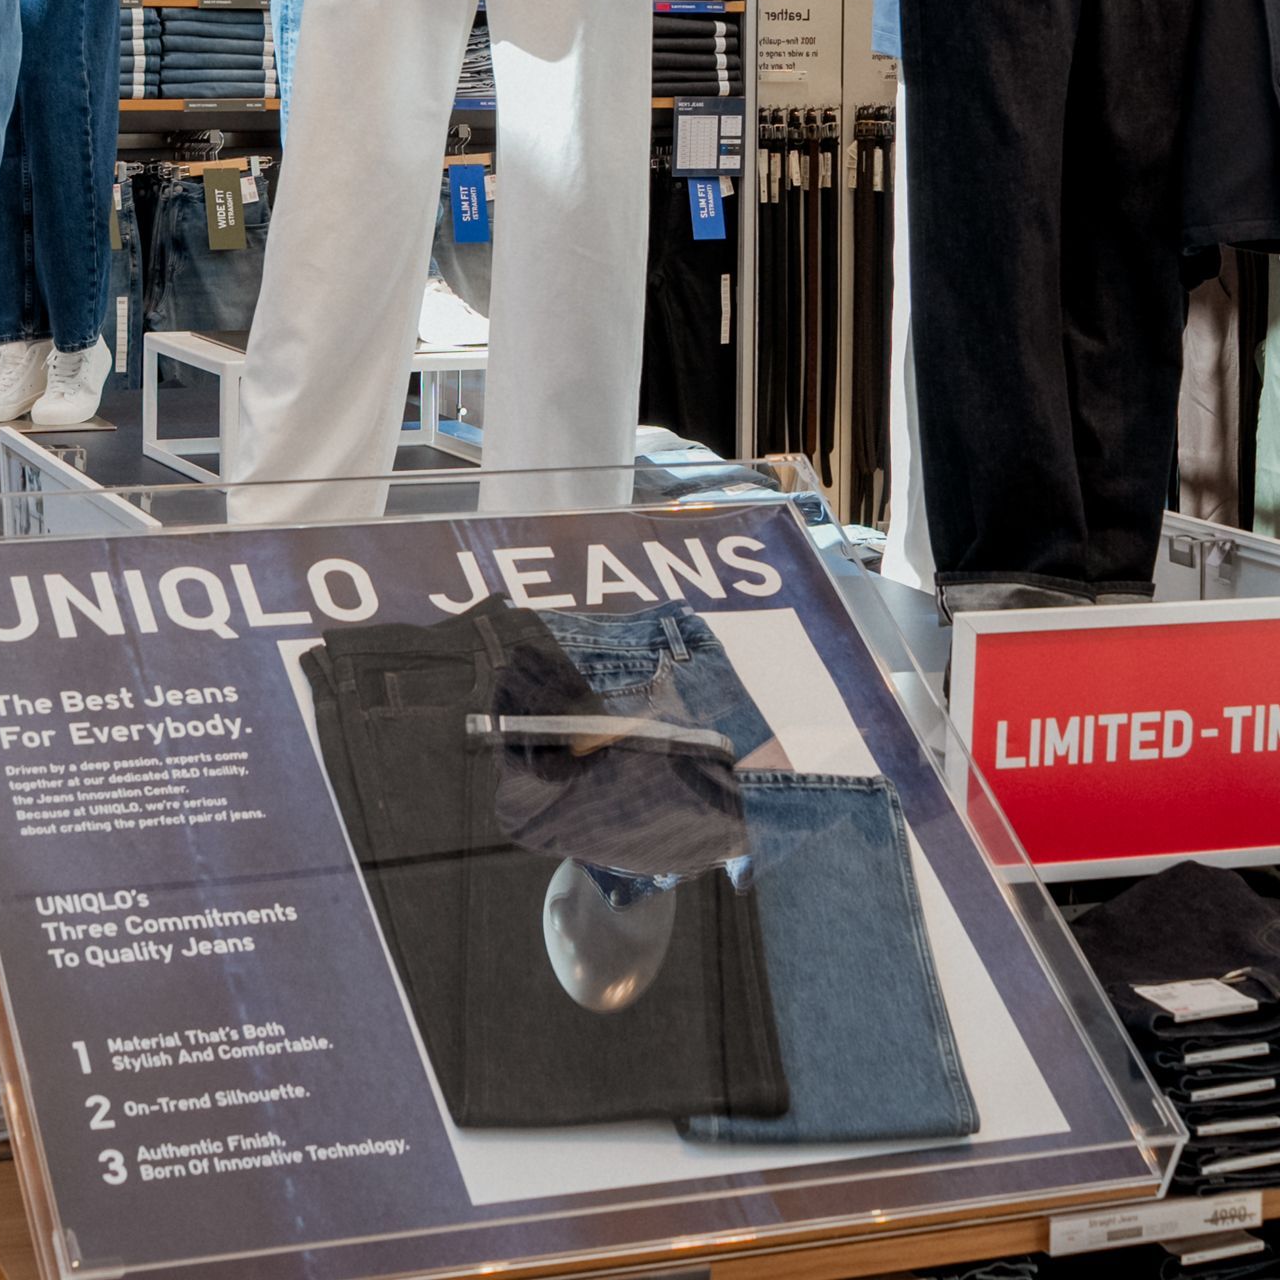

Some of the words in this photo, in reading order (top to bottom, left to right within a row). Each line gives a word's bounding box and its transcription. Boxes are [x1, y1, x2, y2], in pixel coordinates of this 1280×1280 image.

[215, 188, 225, 203] FIT
[460, 186, 469, 199] FIT
[697, 184, 705, 197] FIT
[217, 204, 228, 230] WIDE
[461, 201, 471, 222] SLIM
[699, 201, 708, 218] SLIM
[427, 535, 783, 615] JEANS
[60, 687, 135, 714] Best
[144, 684, 239, 709] Jeans
[68, 713, 254, 748] Everybody.
[5, 765, 48, 777] Driven
[80, 759, 111, 773] deep
[113, 756, 163, 771] passion,
[166, 753, 212, 768] experts
[214, 750, 248, 762] come
[8, 778, 64, 792] together
[108, 770, 170, 785] dedicated
[172, 768, 200, 780] R&D
[36, 791, 75, 804] Jeans
[77, 787, 142, 802] Innovation
[144, 783, 190, 796] Center.
[16, 808, 70, 821] Because
[145, 799, 180, 811] we're
[183, 795, 228, 808] serious
[20, 823, 57, 836] about
[60, 819, 112, 834] crafting
[138, 813, 186, 830] perfect
[188, 811, 213, 826] pair
[230, 808, 266, 823] jeans.
[35, 889, 150, 916] UNIQLO's
[41, 920, 118, 942] Three
[125, 902, 298, 935] Commitments
[47, 948, 80, 969] To
[84, 941, 174, 968] Quality
[180, 934, 256, 958] Jeans
[72, 1040, 92, 1075] 1
[106, 1032, 182, 1055] Material
[185, 1026, 240, 1046] That's
[242, 1021, 286, 1040] Both
[111, 1051, 173, 1073] Stylish
[178, 1047, 215, 1065] And
[217, 1035, 334, 1060] Comfortable.
[84, 1094, 117, 1131] 2
[123, 1092, 212, 1118] On-Trend
[214, 1084, 311, 1107] Silhouette.
[98, 1148, 129, 1185] 3
[136, 1138, 224, 1162] Authentic
[139, 1164, 186, 1182] Born
[189, 1159, 211, 1176] Of
[214, 1151, 304, 1173] Innovative
[305, 1137, 411, 1162] Technology.
